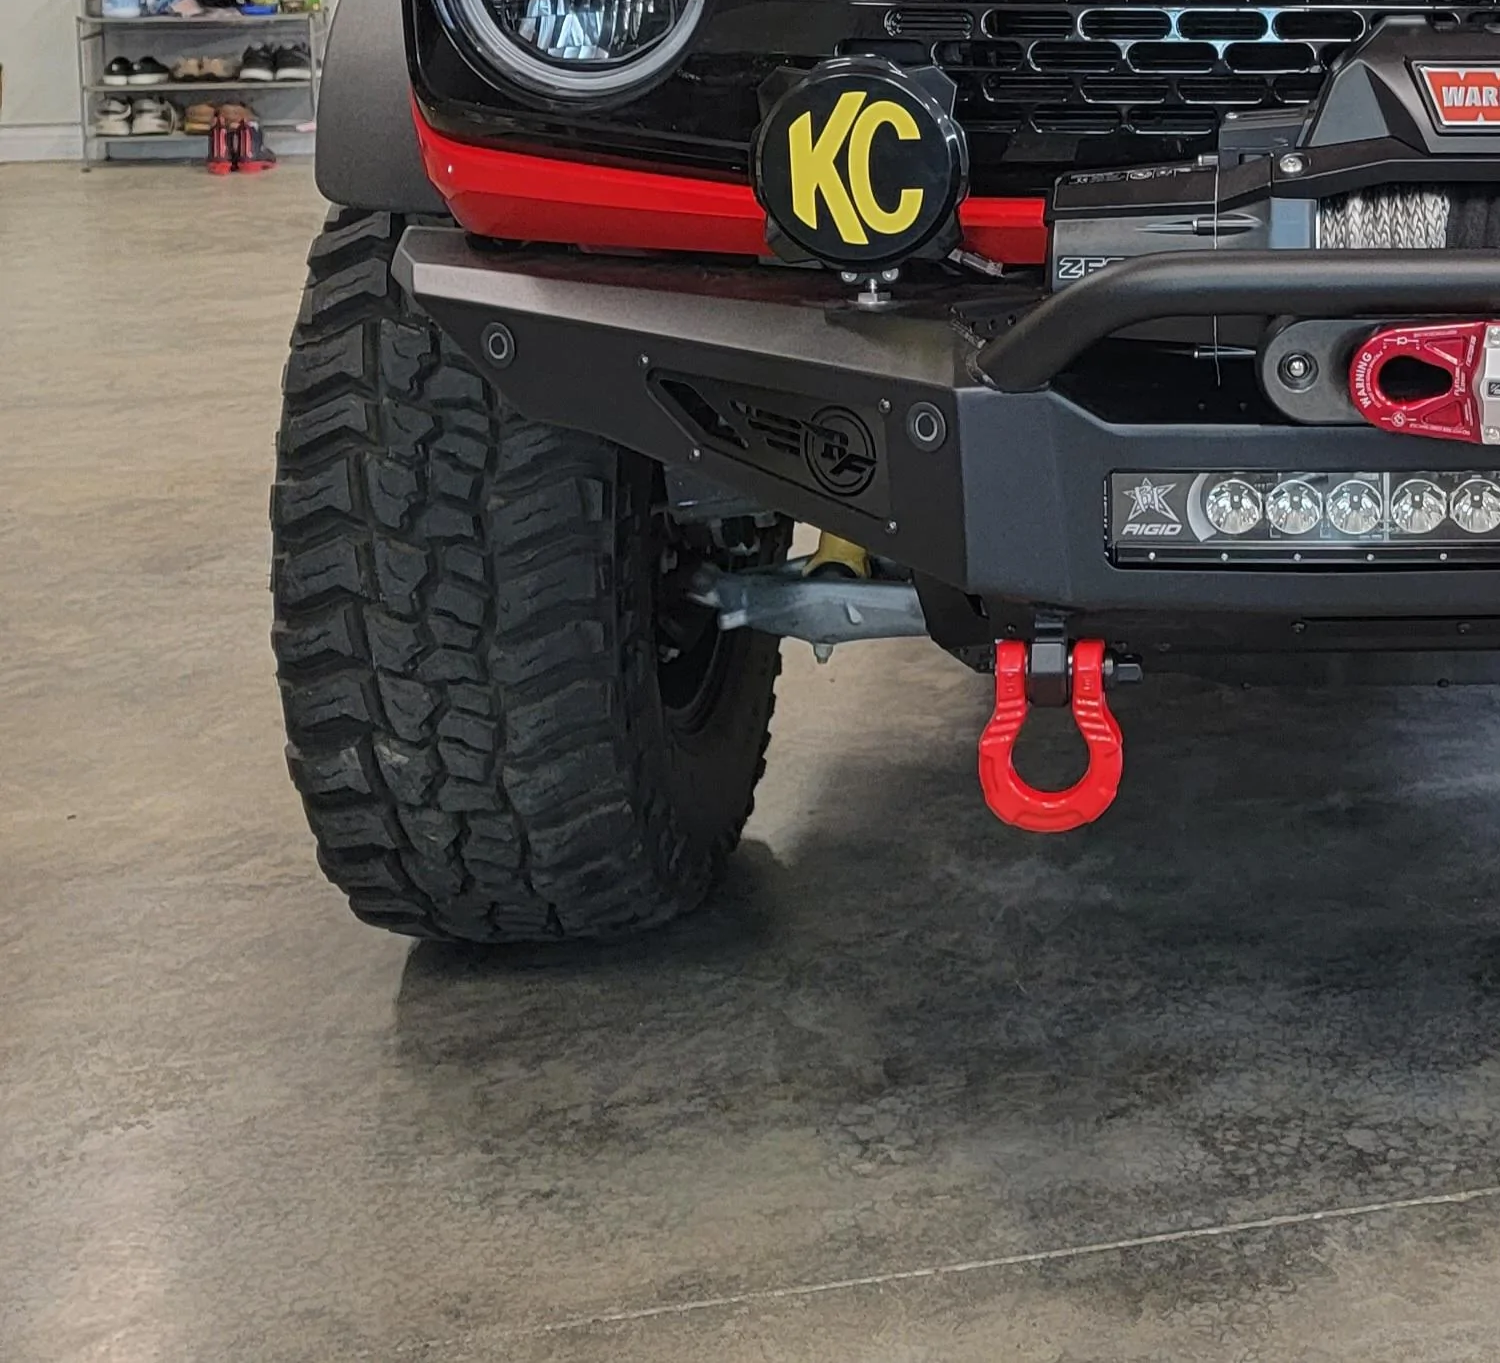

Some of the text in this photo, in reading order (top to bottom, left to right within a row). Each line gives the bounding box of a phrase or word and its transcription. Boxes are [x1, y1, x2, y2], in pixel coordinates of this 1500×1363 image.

[788, 91, 924, 245] KC
[1355, 351, 1372, 409] WARNING
[1121, 523, 1182, 536] RIGID
